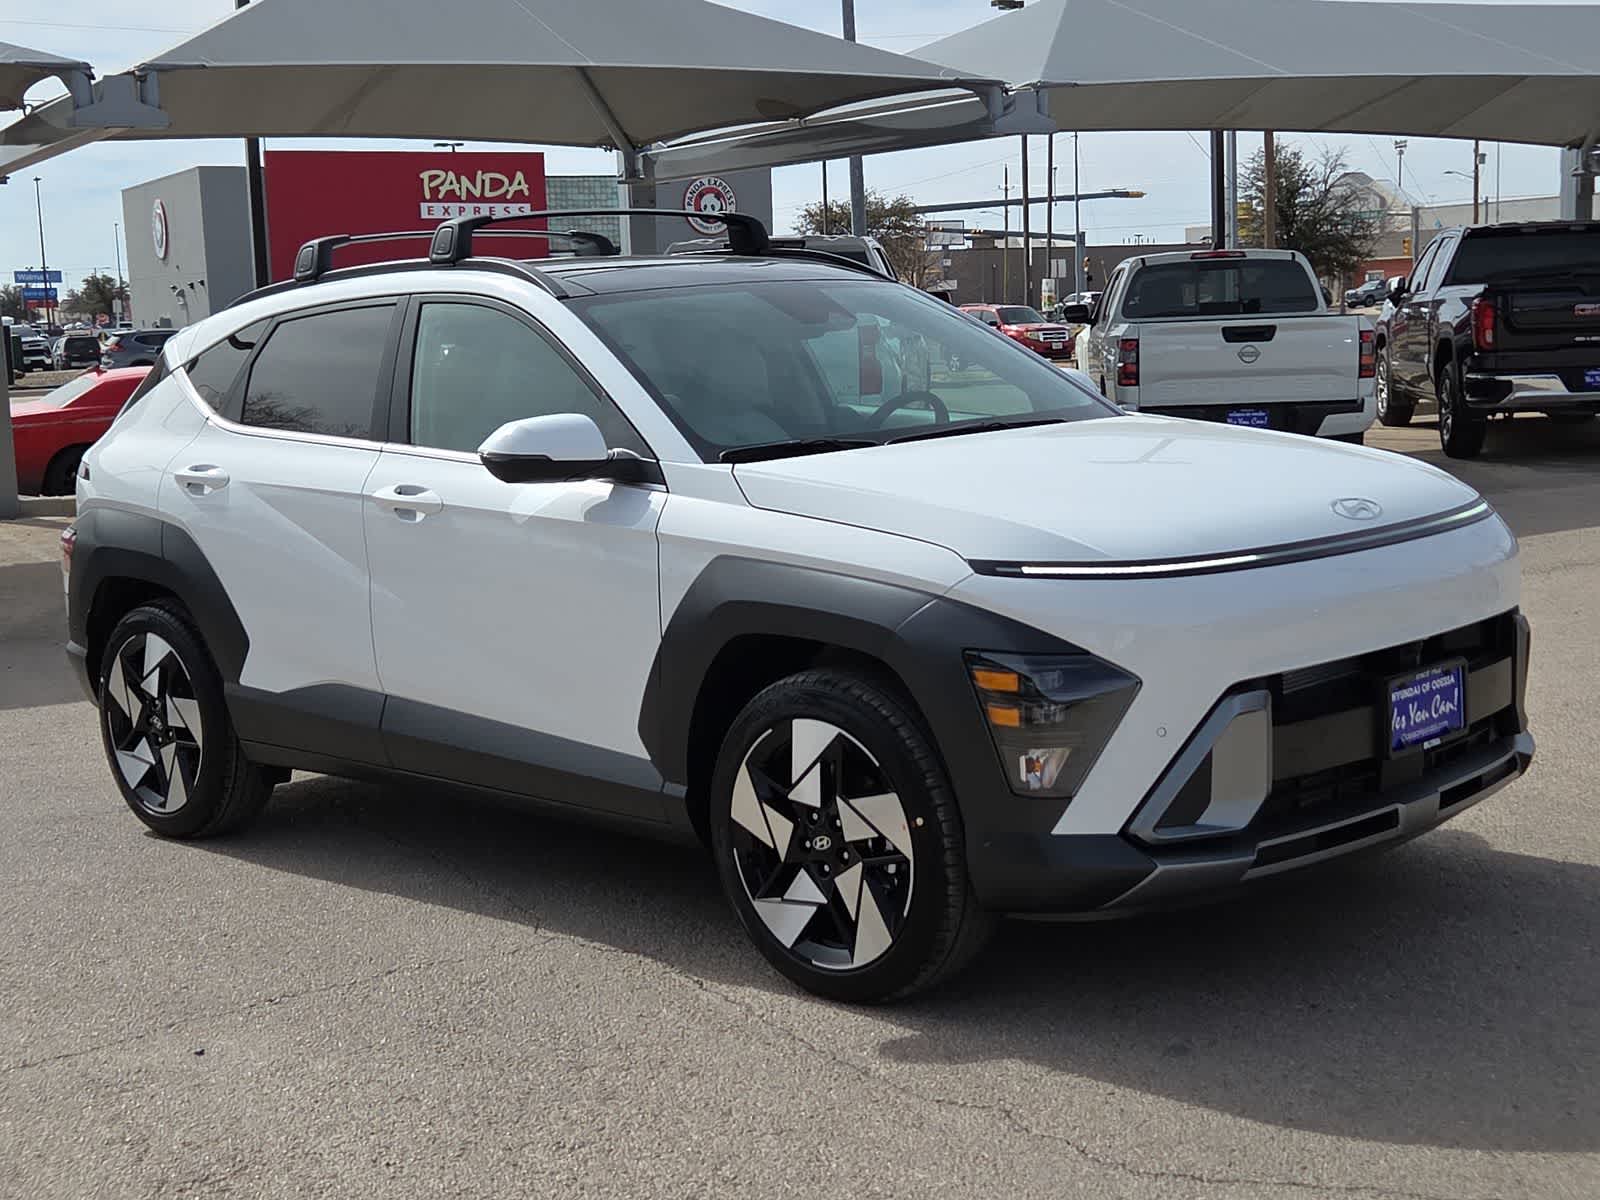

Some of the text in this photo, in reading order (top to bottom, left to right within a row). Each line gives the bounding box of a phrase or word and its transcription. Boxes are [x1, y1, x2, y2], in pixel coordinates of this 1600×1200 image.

[419, 169, 530, 201] PANDA
[686, 178, 735, 207] PANDA EXPRESS
[426, 205, 526, 216] EXPRESS
[1421, 682, 1431, 694] OF
[1409, 701, 1430, 726] You
[1431, 687, 1459, 718] Can!
